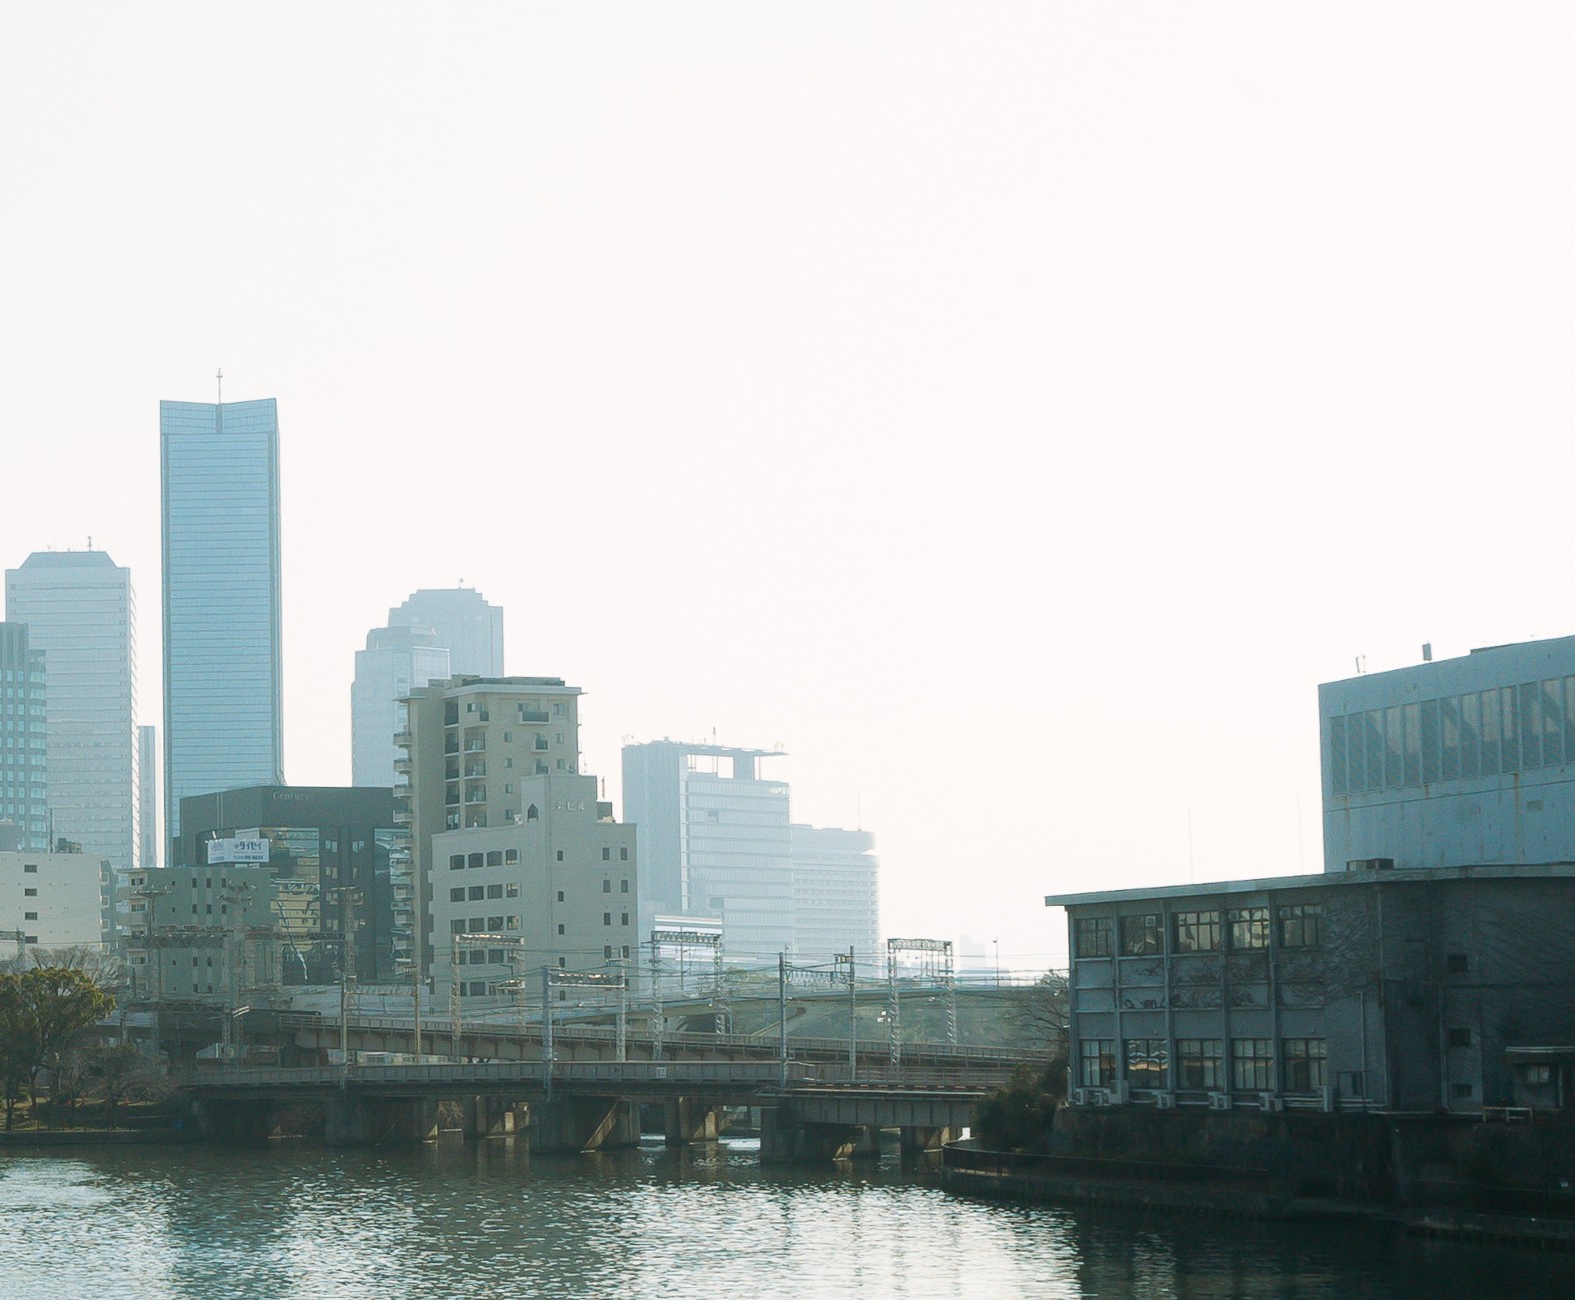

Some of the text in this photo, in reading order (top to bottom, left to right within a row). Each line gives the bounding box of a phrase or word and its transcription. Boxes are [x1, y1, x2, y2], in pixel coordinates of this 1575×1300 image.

[272, 791, 310, 800] Century
[239, 841, 262, 850] タイセイ
